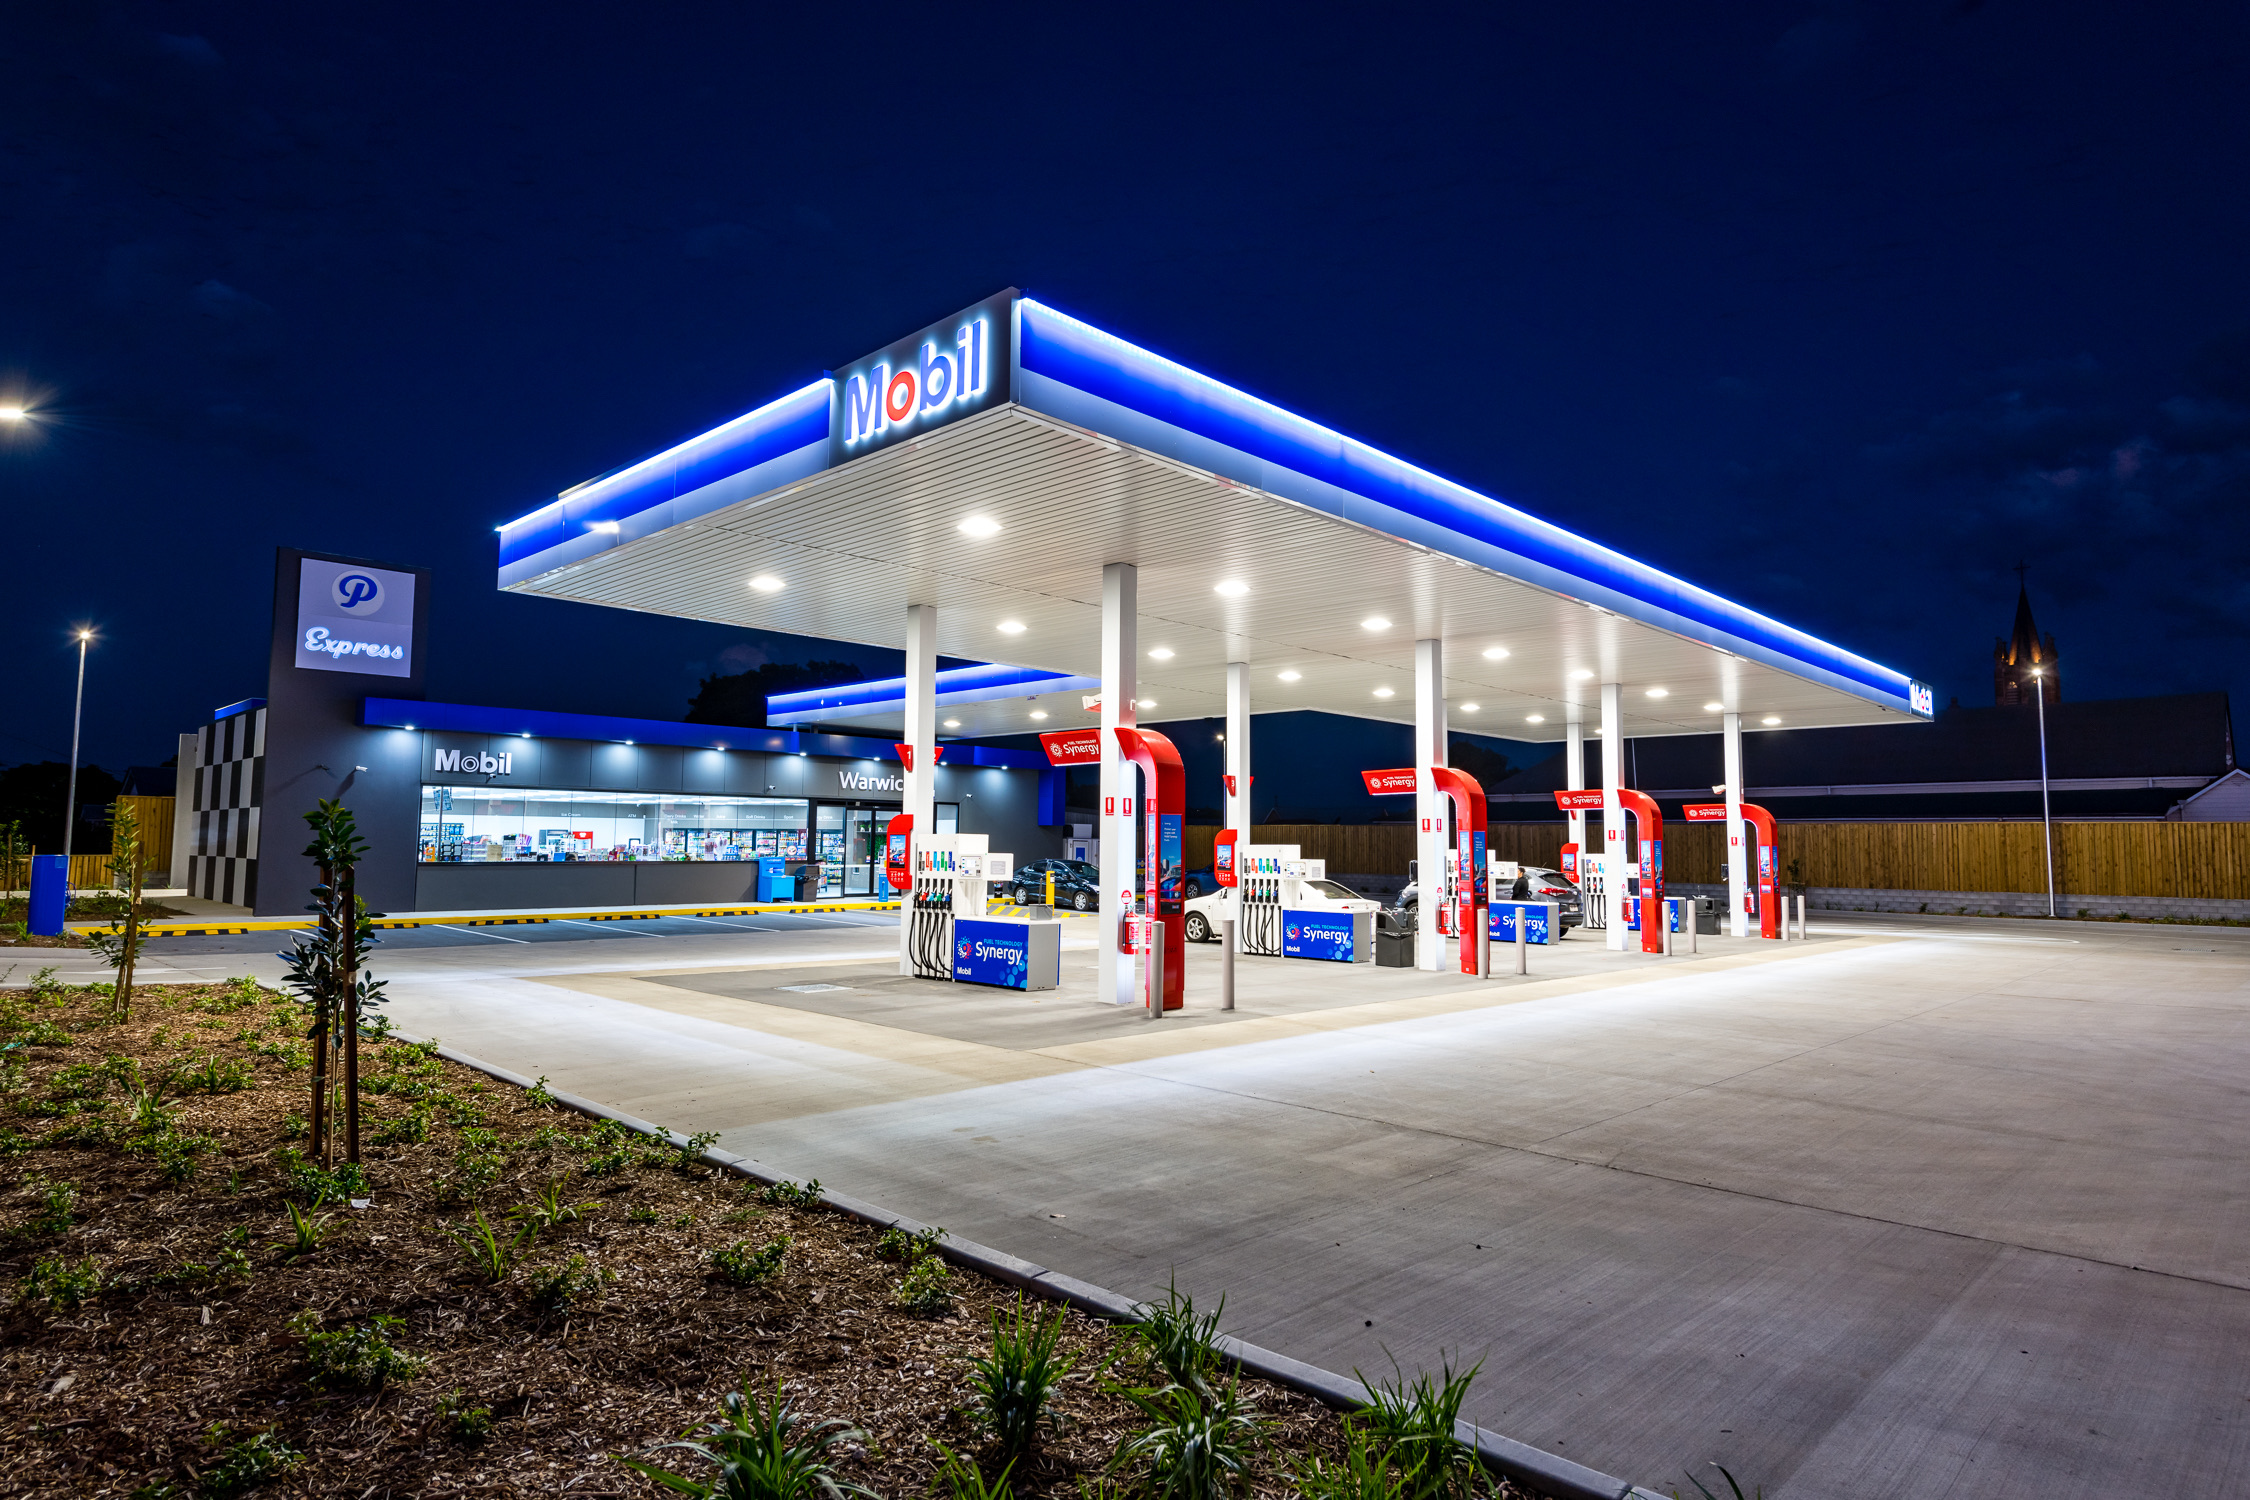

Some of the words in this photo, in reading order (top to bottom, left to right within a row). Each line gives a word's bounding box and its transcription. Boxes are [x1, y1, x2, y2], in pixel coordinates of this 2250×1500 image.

[845, 319, 985, 444] Mobil
[304, 626, 404, 660] Express
[906, 750, 911, 760] 1
[1063, 743, 1099, 756] Synergy
[434, 748, 512, 774] Mobil
[839, 771, 904, 791] Warwic
[1382, 778, 1415, 788] Synergy
[1572, 796, 1602, 805] Synergy
[1503, 915, 1545, 930] Syrgy
[1303, 926, 1349, 944] Synergy
[994, 939, 1024, 947] TECHNOLOGY
[1286, 945, 1301, 953] Mobil
[975, 941, 1023, 966] Synergy
[956, 966, 972, 976] Mobil
